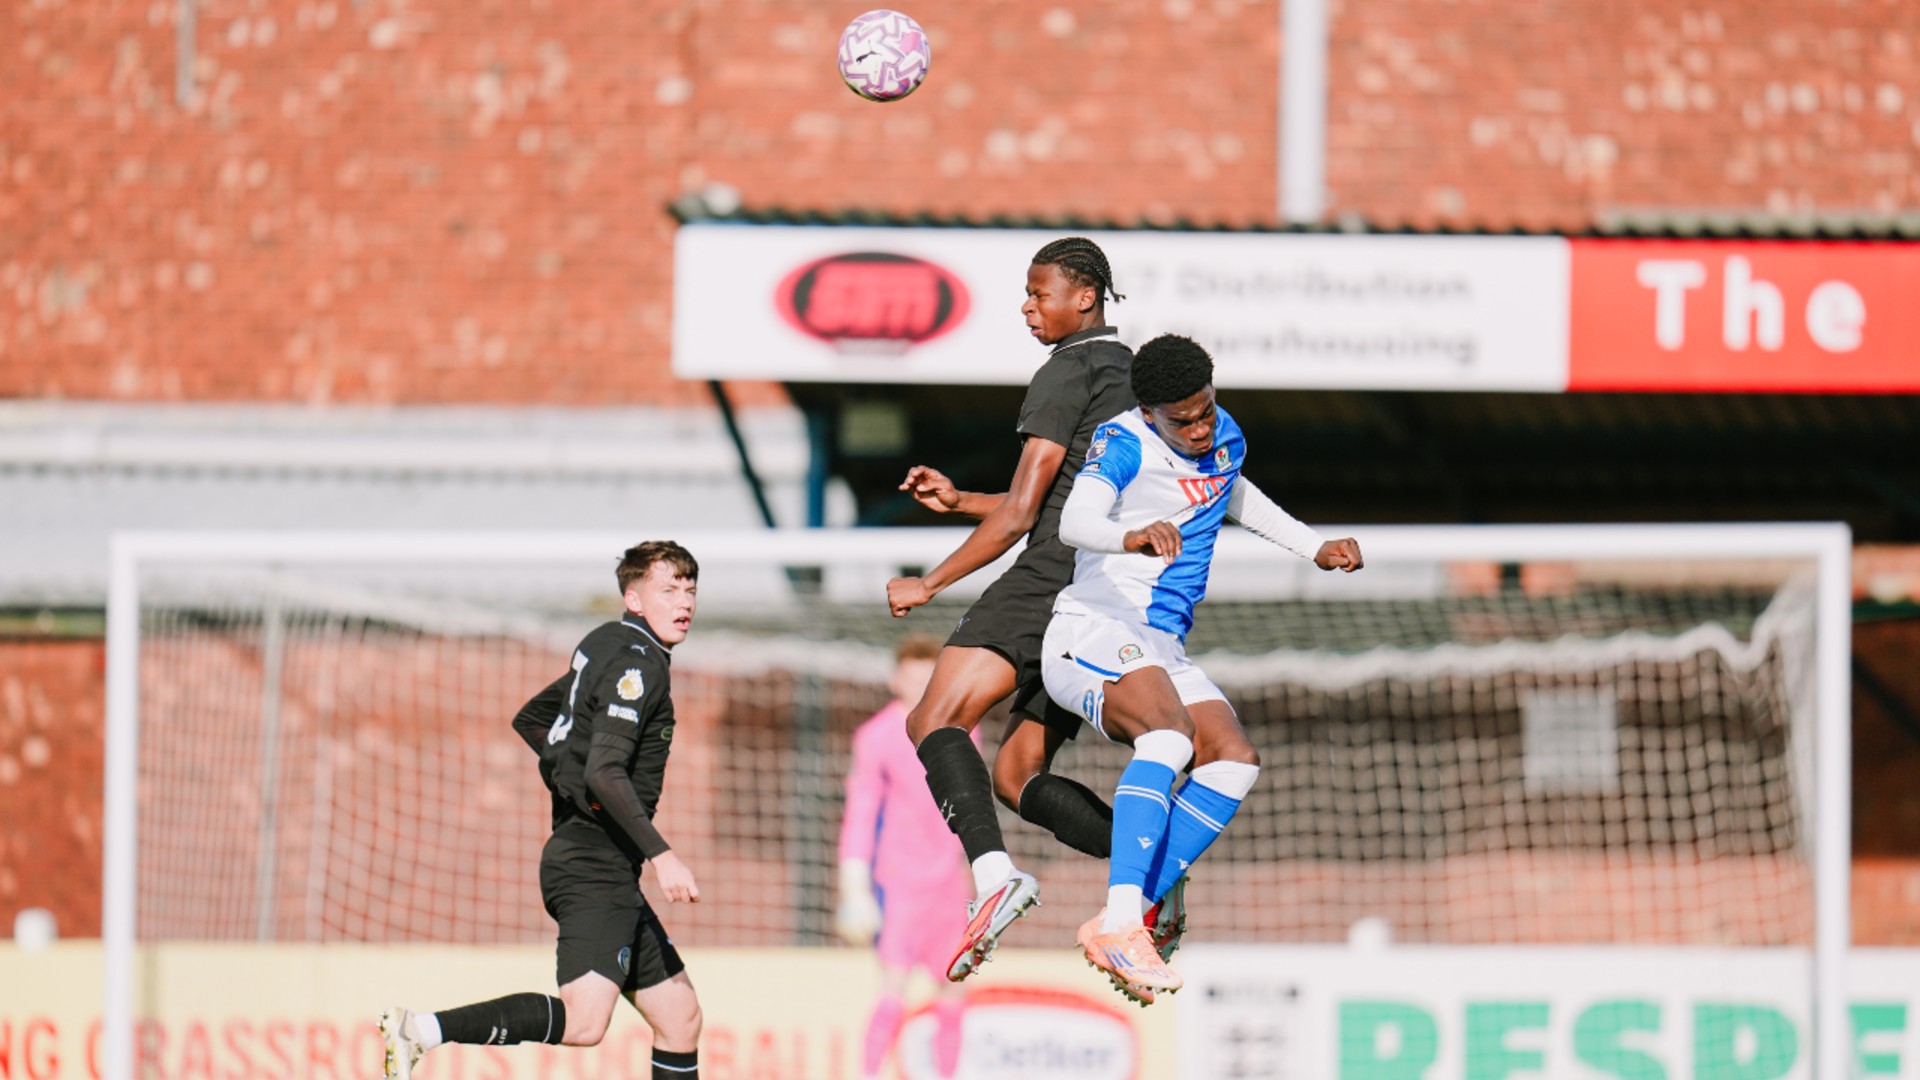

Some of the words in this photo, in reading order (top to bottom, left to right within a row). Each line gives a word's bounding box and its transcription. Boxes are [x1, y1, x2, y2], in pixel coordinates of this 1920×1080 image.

[1636, 255, 1867, 352] The
[1178, 322, 1480, 367] arehousing
[84, 1018, 513, 1080] RASSROS
[540, 1022, 848, 1080] OOBALL
